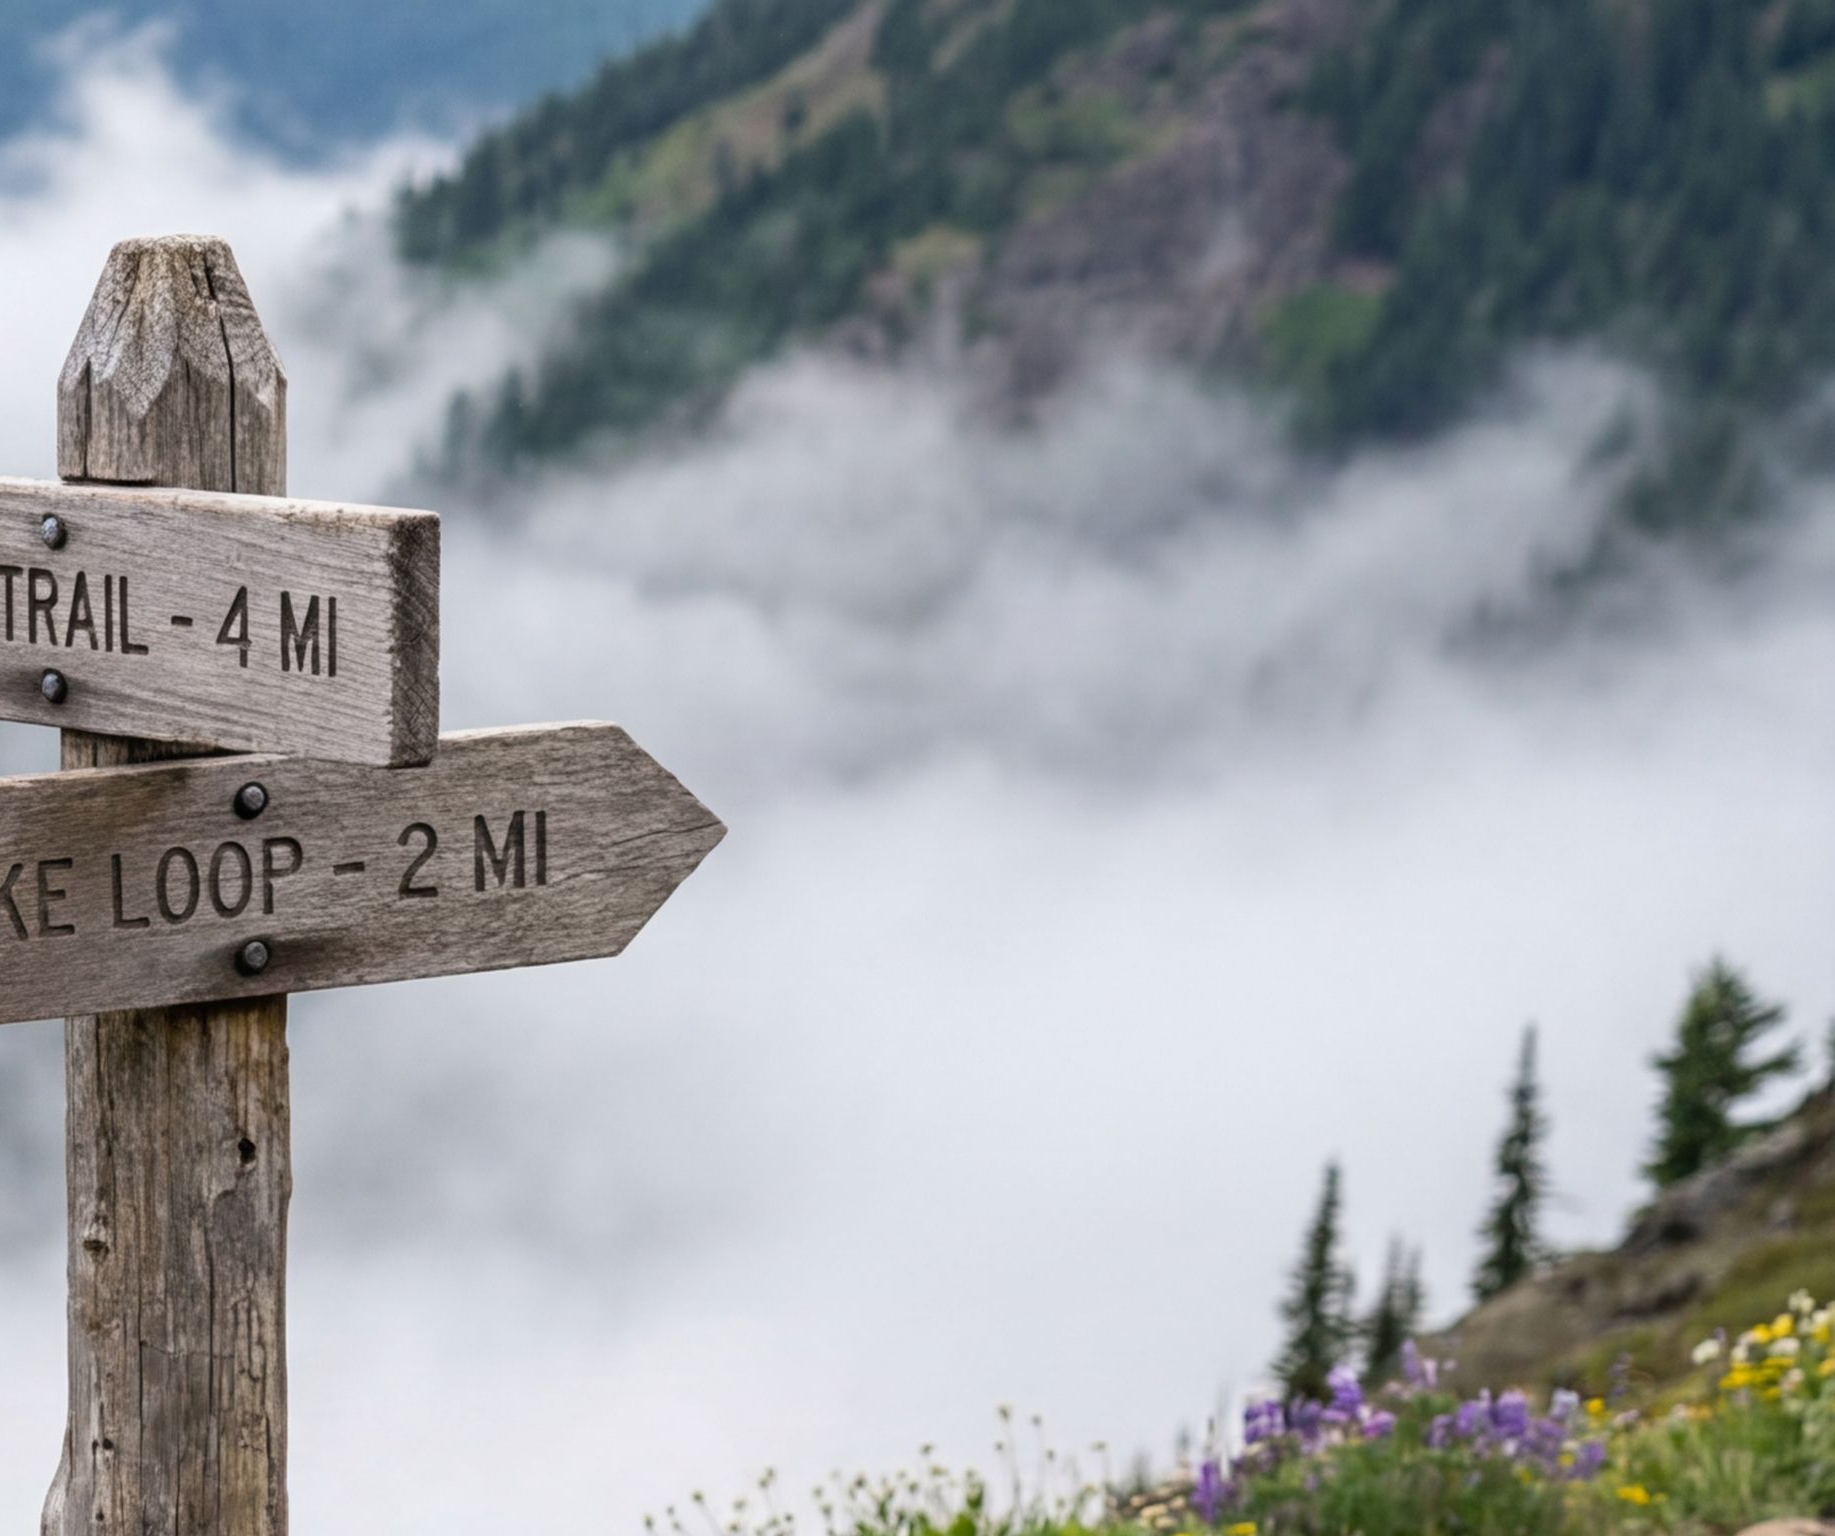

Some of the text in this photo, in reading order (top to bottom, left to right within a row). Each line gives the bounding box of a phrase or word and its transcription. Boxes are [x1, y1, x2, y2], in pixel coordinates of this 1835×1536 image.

[170, 614, 194, 628] -
[216, 584, 253, 669] 4
[280, 590, 338, 678] MI
[111, 836, 304, 928] LOOP
[332, 861, 366, 876] -
[397, 821, 439, 900] 2
[473, 809, 548, 892] MI
